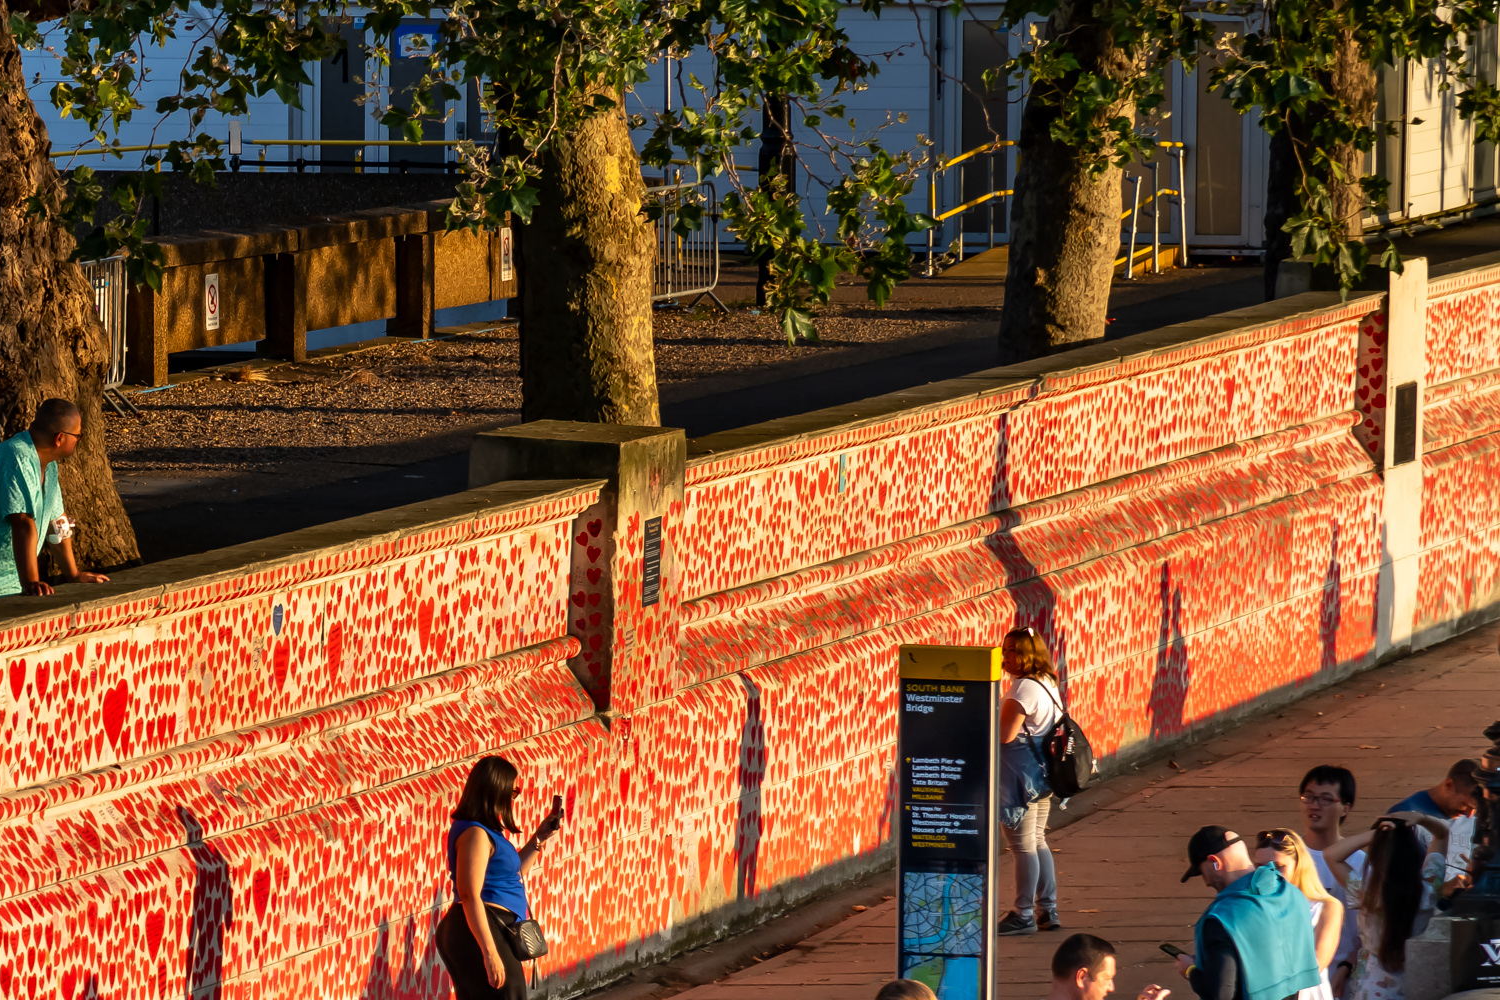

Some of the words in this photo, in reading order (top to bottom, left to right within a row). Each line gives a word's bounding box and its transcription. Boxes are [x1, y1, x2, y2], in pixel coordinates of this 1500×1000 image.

[940, 685, 966, 693] BANK
[906, 694, 964, 703] Westminster
[906, 704, 934, 714] Bridge
